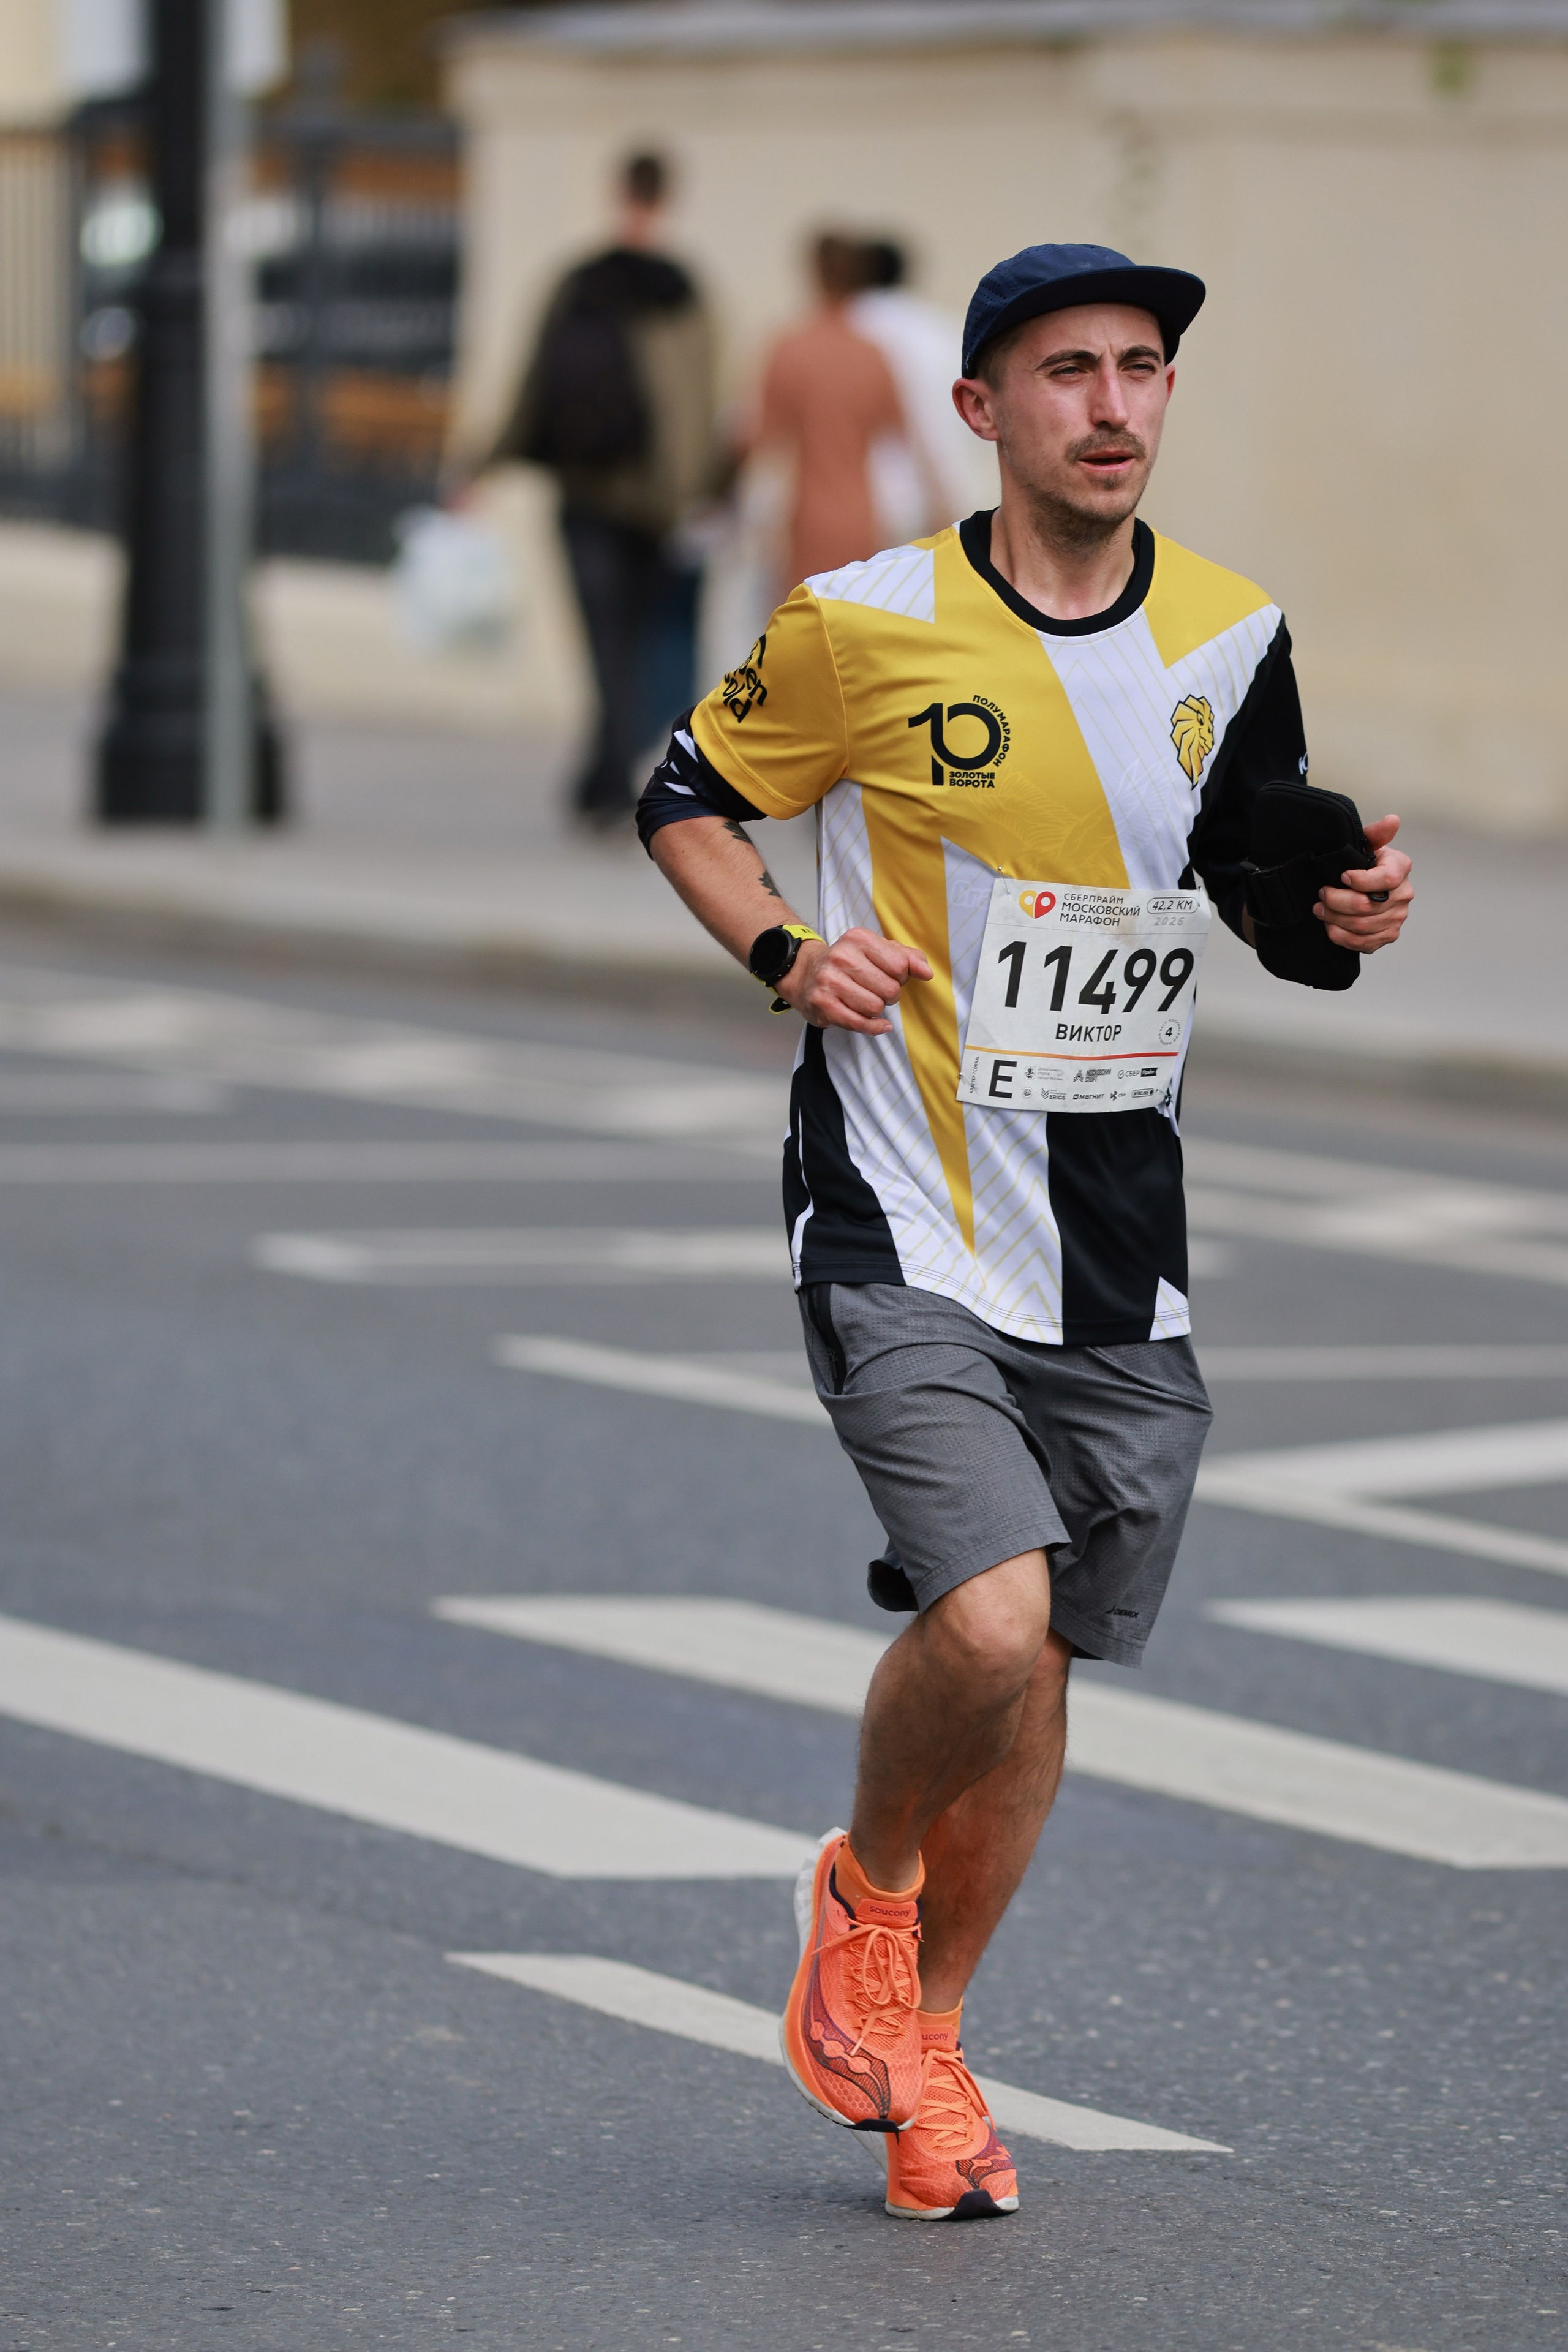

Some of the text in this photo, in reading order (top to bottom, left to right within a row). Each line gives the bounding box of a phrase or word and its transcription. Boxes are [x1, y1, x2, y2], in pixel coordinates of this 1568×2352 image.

[972, 695, 1011, 767] ПОЛУМАРАФОН
[908, 703, 1001, 786] 10
[949, 778, 995, 788] ВОРОТА
[1063, 893, 1124, 905] СБЕРПРАЙМ
[1152, 900, 1174, 911] 42,2
[1061, 902, 1140, 916] МОСКОВСКИЙ
[1060, 913, 1120, 927] МАРАФОН
[1153, 917, 1185, 926] 2026
[998, 941, 1194, 1015] 11499
[1055, 1023, 1122, 1042] ВИКТОР
[1165, 1027, 1173, 1037] 4
[988, 1059, 1017, 1099] E
[1114, 1608, 1140, 1618] DEMIX
[869, 1905, 911, 1917] saucony
